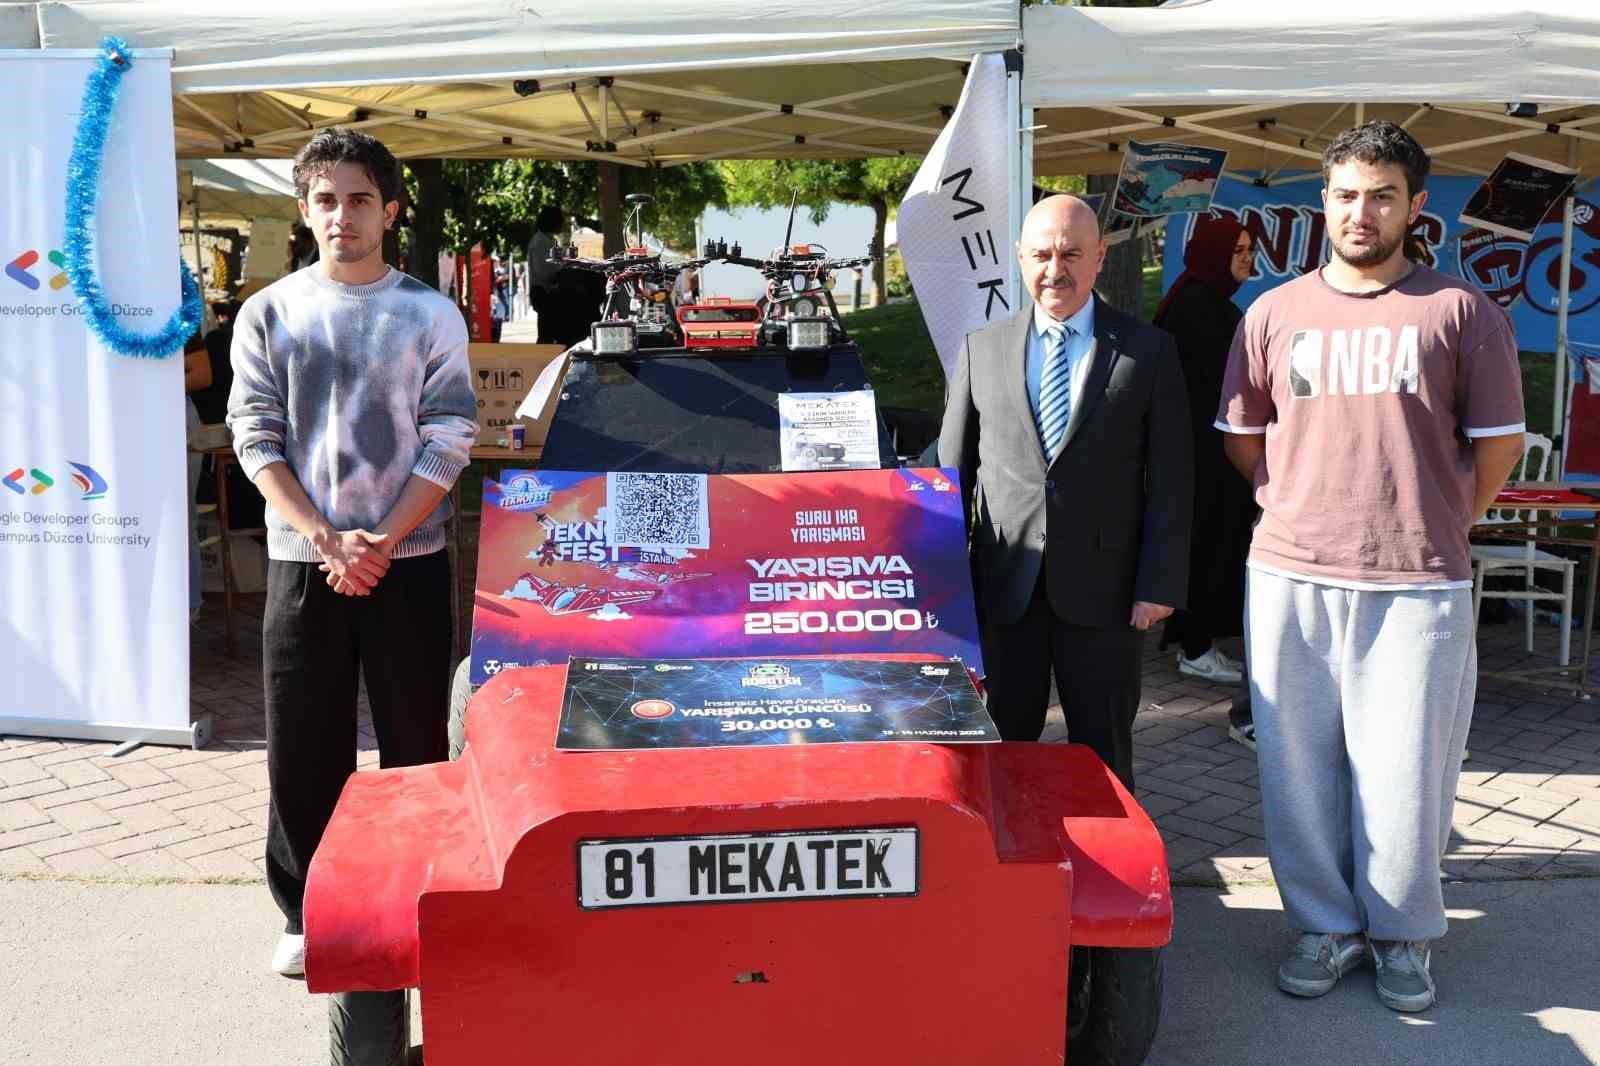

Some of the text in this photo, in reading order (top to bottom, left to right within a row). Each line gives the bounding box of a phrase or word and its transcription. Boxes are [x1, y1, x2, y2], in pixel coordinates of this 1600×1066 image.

[0, 303, 57, 318] eveloper
[112, 303, 153, 316] Düzce
[1327, 325, 1418, 395] NBA
[0, 511, 140, 527] gle Developer Groups
[0, 530, 151, 549] ampus Düzce University
[544, 520, 610, 541] TEKN
[791, 525, 866, 544] YARIŞMASI
[558, 541, 619, 561] FEST
[746, 555, 913, 579] YARIŞMA
[680, 703, 872, 718] YARIŞMA ÜÇÜNCÜSÜ
[760, 698, 793, 706] Hava
[720, 718, 812, 732] 30.000
[605, 838, 892, 899] 81 MEKATEK
